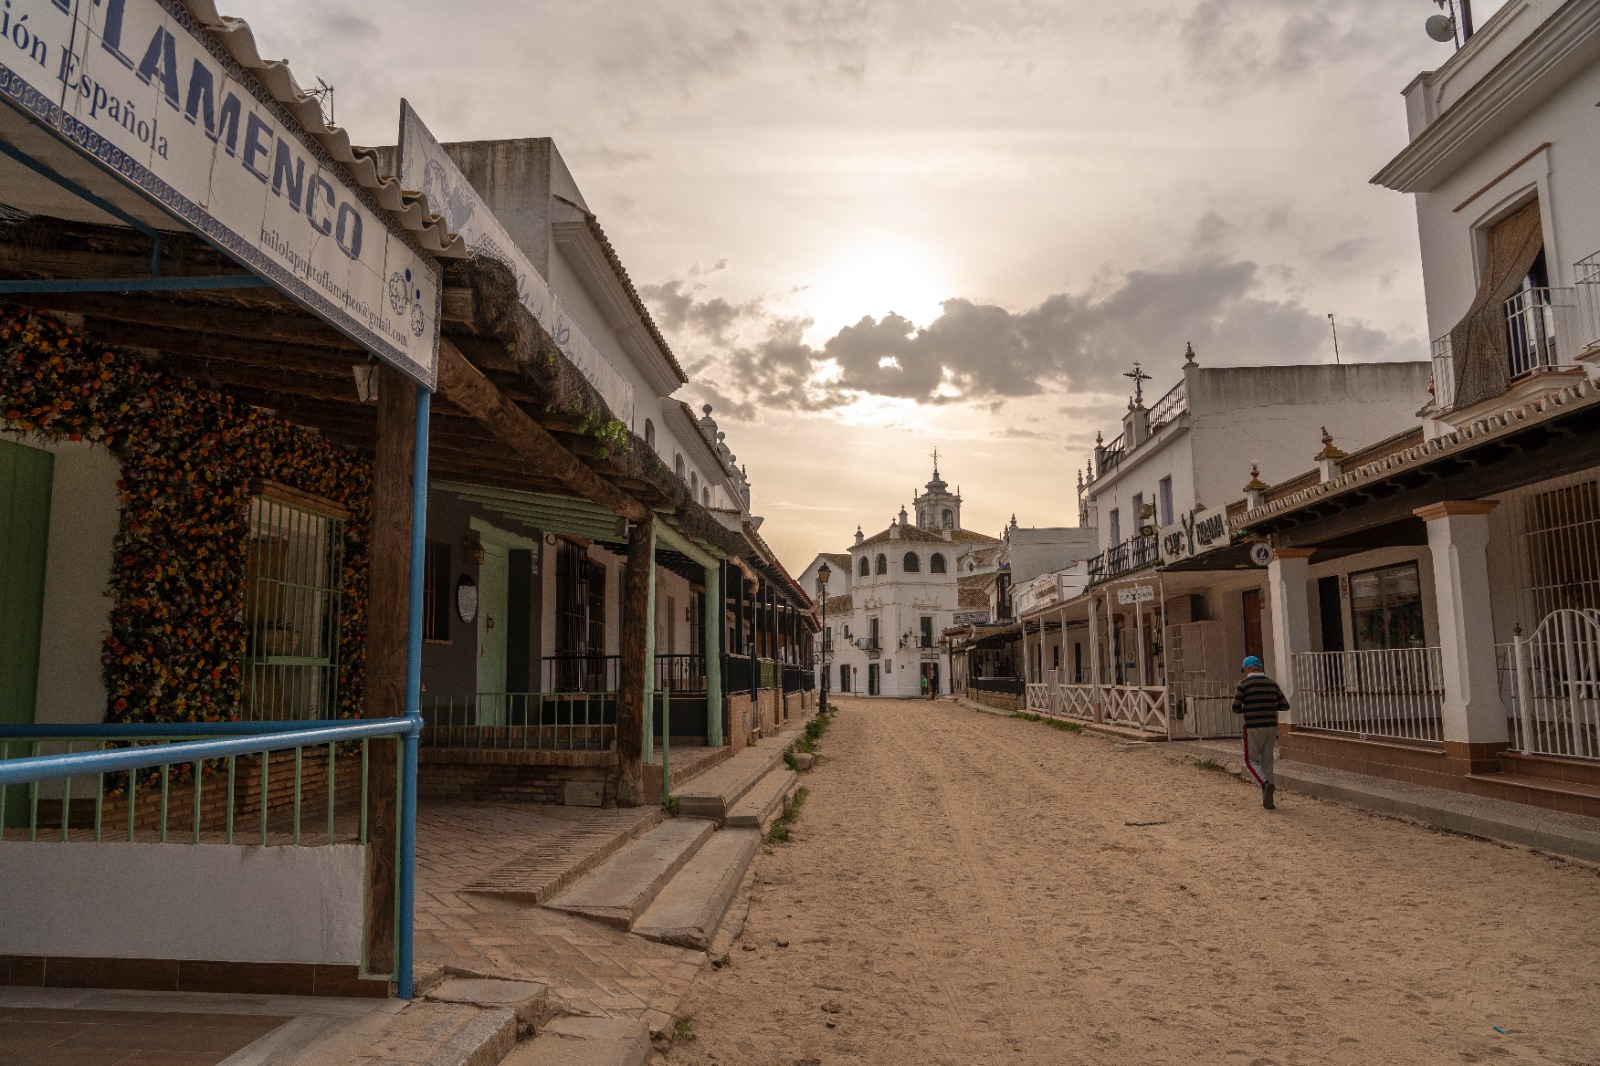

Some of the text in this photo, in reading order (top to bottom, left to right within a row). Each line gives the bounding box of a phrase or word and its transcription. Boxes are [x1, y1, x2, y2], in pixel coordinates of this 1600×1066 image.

[56, 45, 169, 161] Española
[260, 226, 409, 348] milolapuntoflamenco@gmail.com
[1181, 509, 1195, 556] Y
